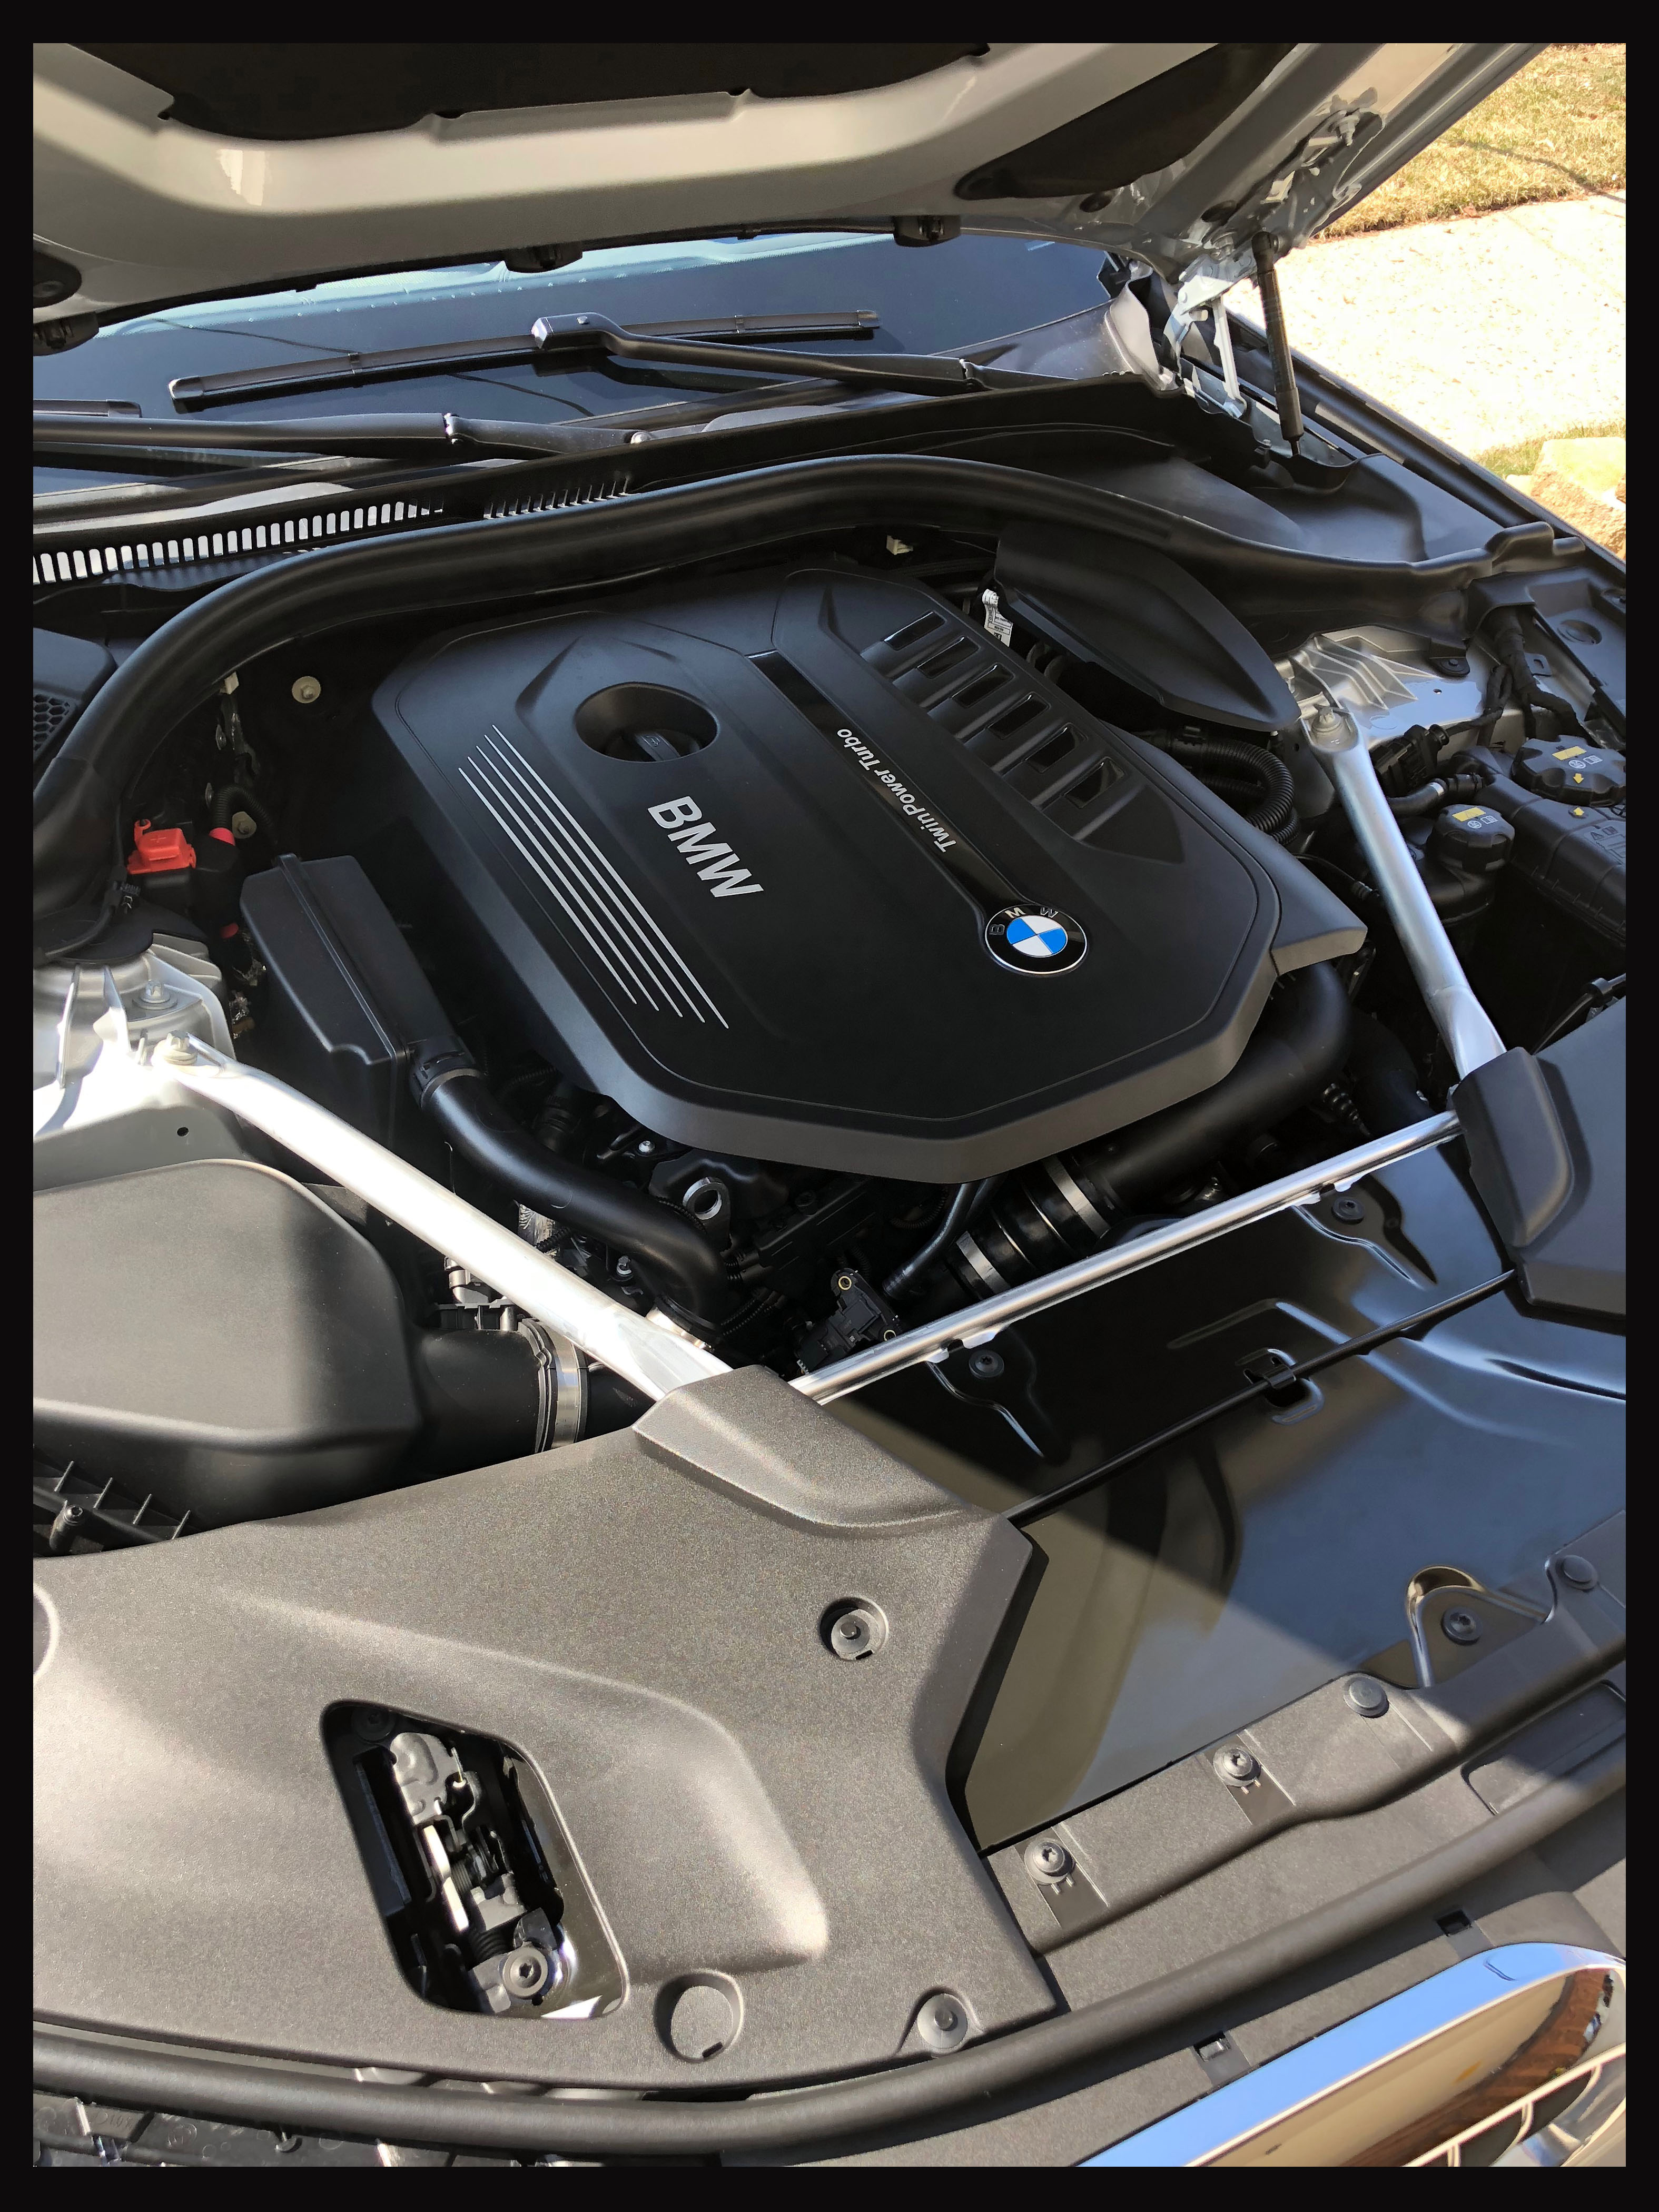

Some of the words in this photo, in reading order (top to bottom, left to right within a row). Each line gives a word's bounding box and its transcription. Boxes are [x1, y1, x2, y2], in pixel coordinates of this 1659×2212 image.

[837, 729, 881, 771] Turbo
[874, 769, 956, 853] TwinPower
[647, 796, 764, 898] BMW
[989, 907, 1059, 935] BMW
